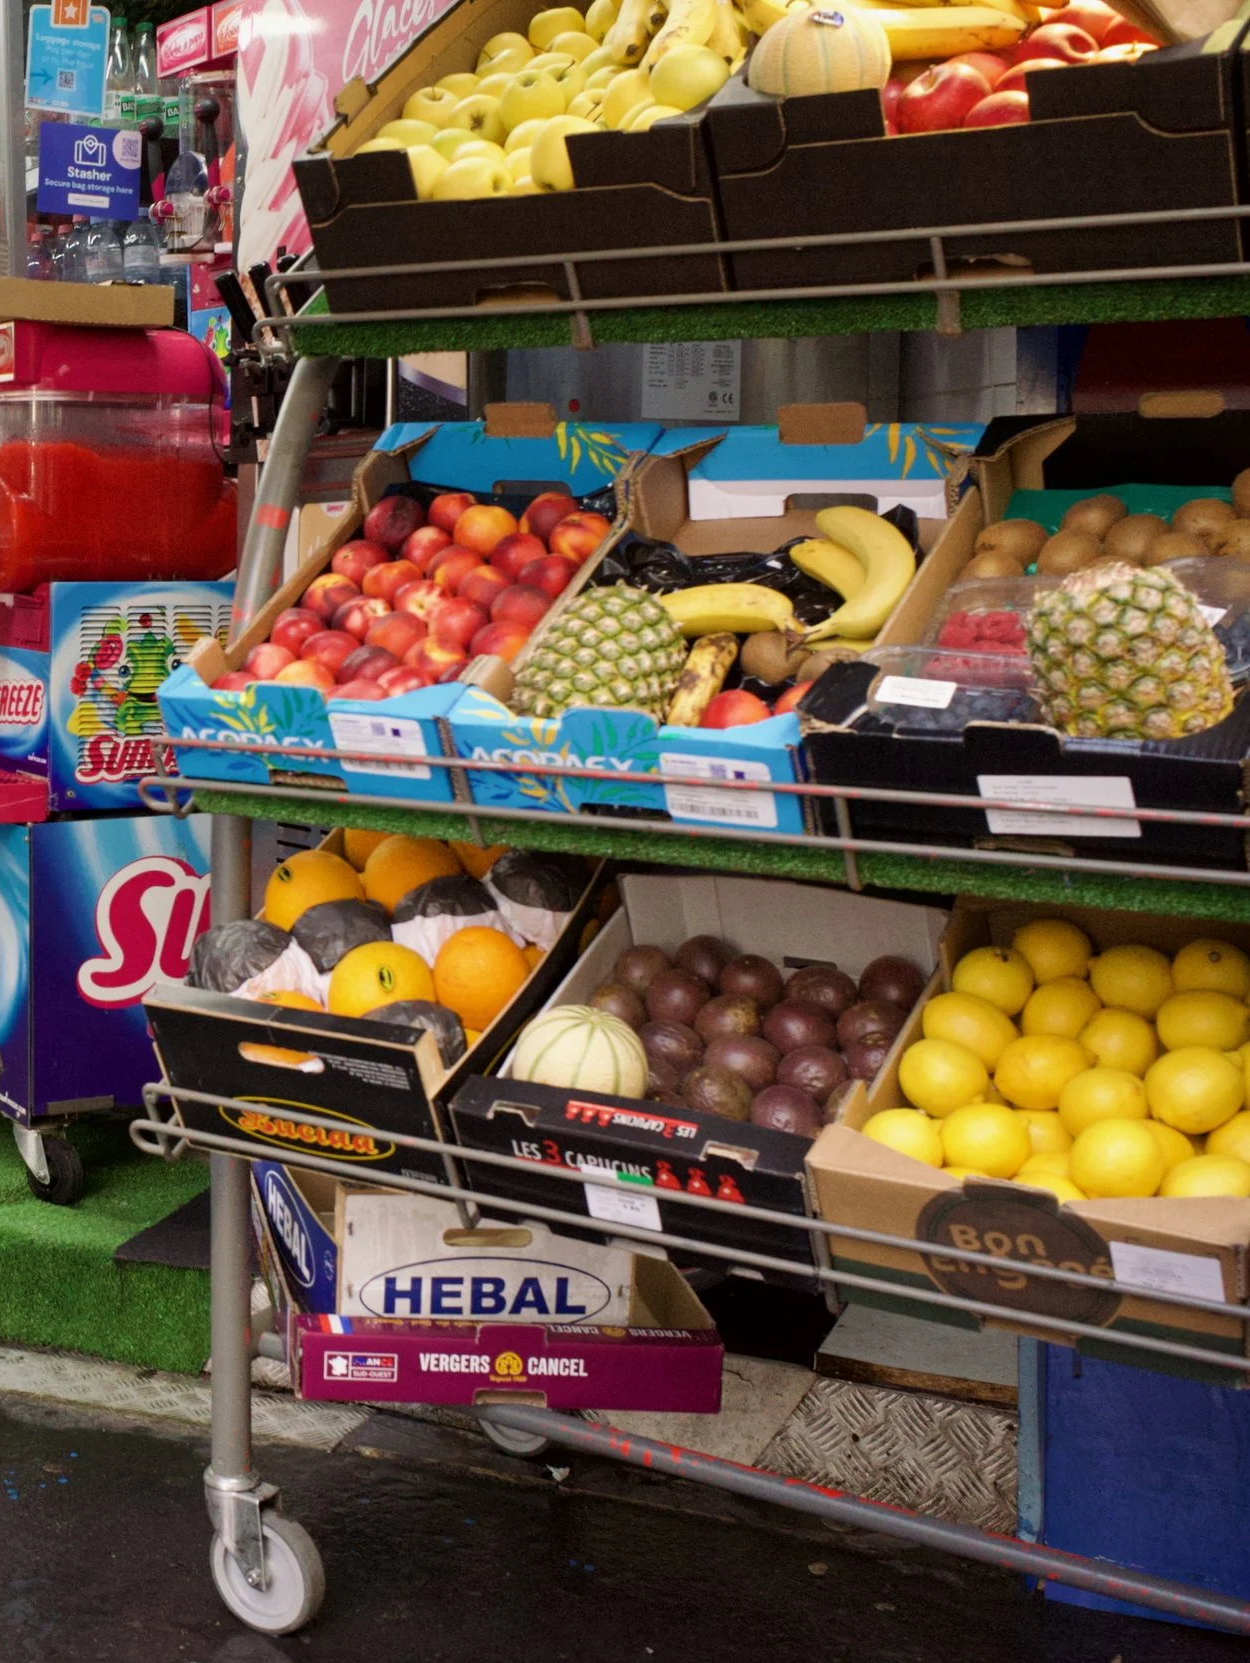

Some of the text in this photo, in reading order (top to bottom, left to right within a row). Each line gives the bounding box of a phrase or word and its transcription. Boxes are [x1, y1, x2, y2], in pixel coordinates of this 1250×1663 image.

[36, 33, 101, 51] Luggage storage
[67, 166, 112, 181] Stasher
[44, 178, 134, 195] Secure bag storage here
[612, 1112, 664, 1133] CAPUCINS
[676, 1124, 698, 1139] LES
[511, 1139, 651, 1179] LES 3 CAPUCINS
[268, 1176, 310, 1282] HEBAL
[950, 1224, 1048, 1259] Bon
[383, 1276, 586, 1315] HEBAL
[550, 1324, 691, 1339] VERGERS CANCEL
[419, 1352, 588, 1377] VERGERS CANCEL
